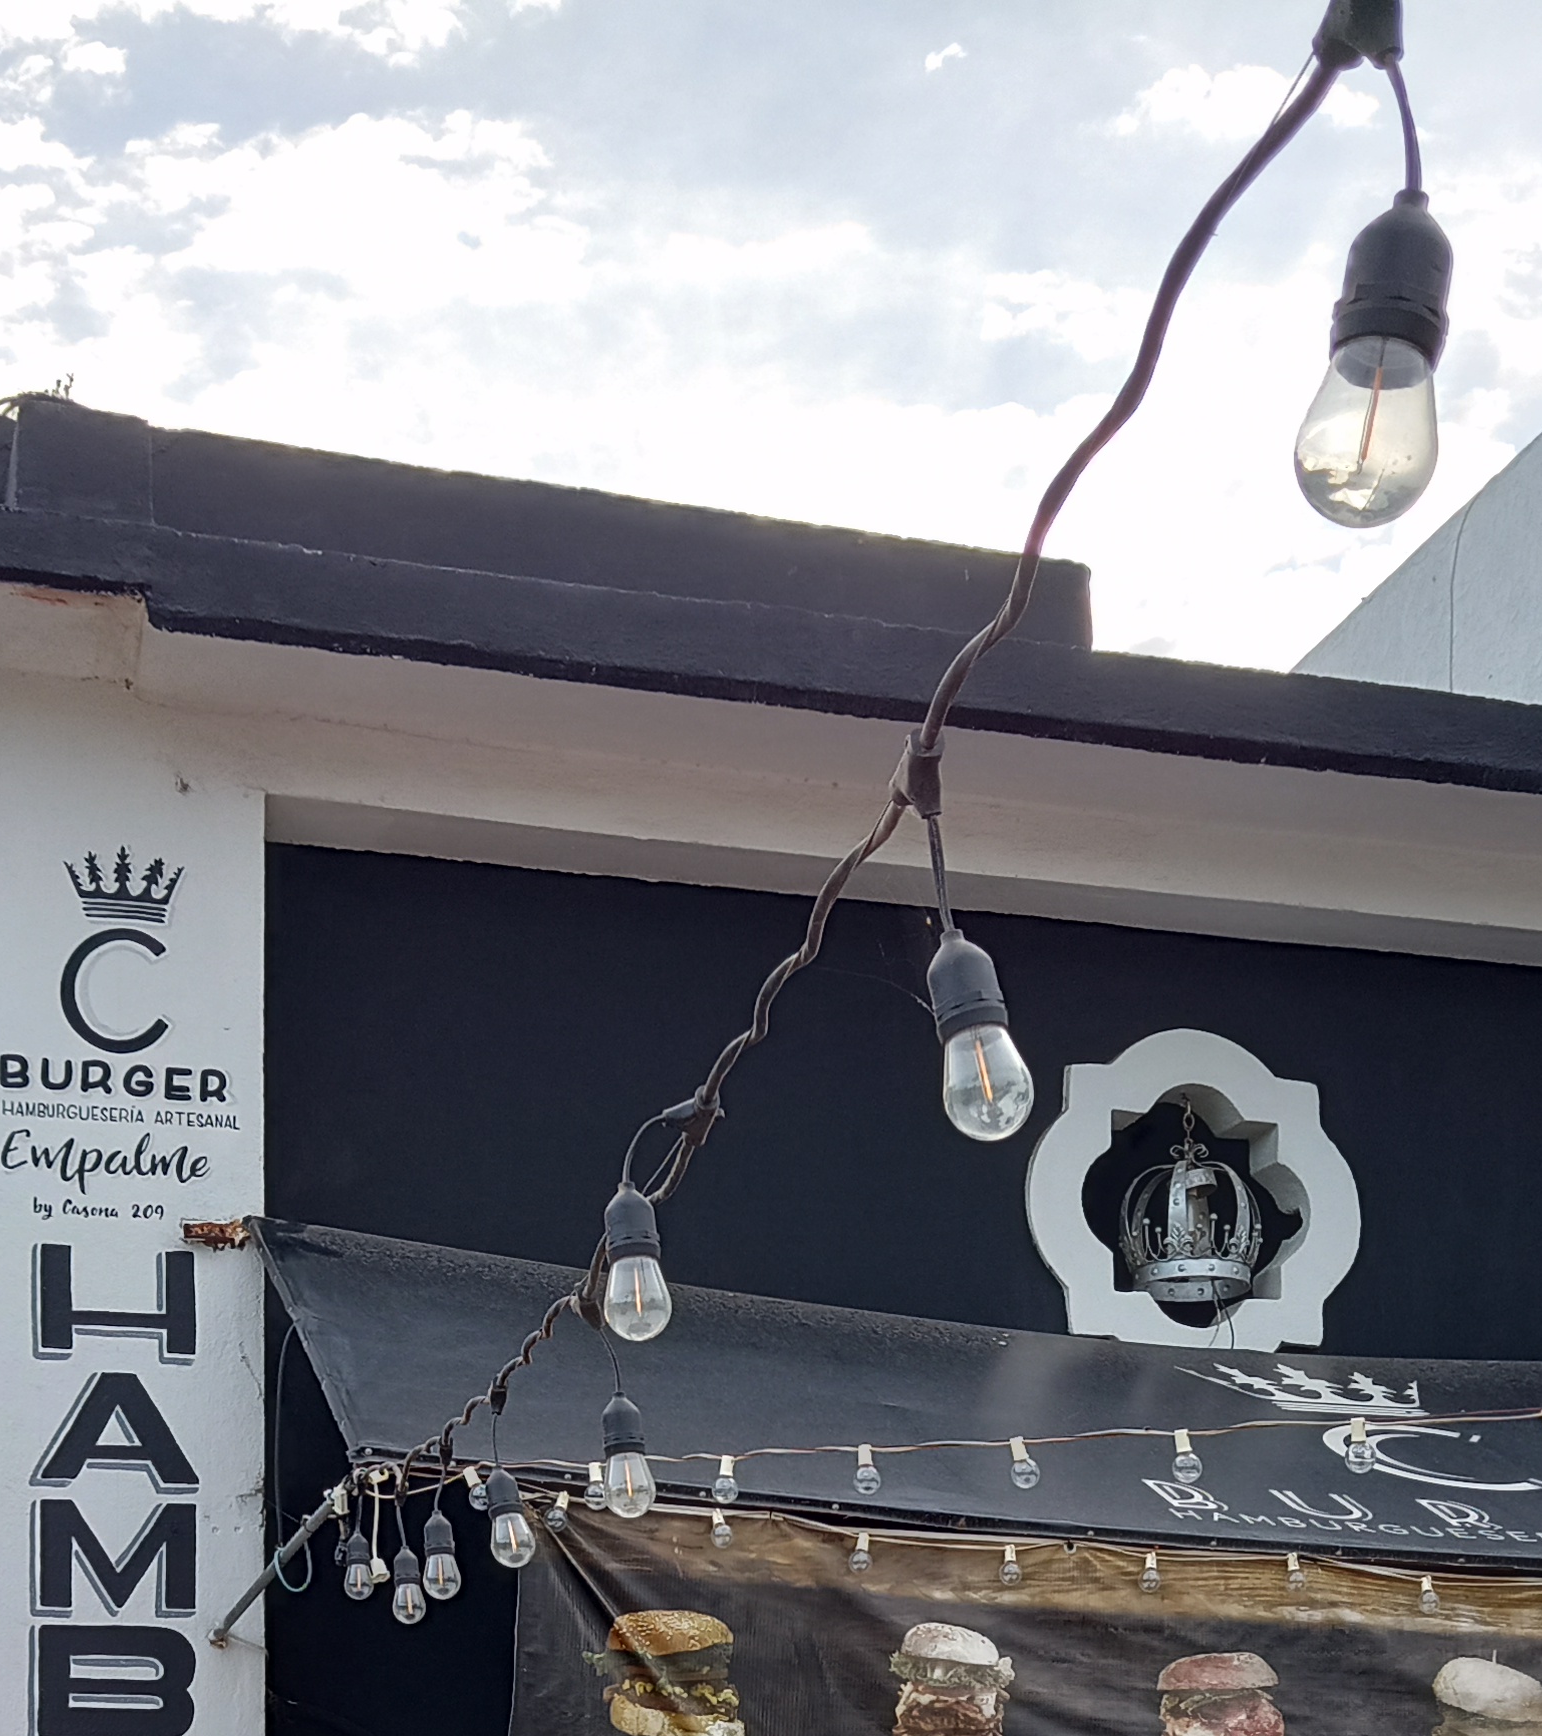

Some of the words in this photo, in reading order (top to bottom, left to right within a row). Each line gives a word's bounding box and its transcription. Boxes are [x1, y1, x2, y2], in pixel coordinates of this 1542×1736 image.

[59, 927, 170, 1055] C
[153, 1110, 241, 1131] ARTESANAL
[0, 1128, 211, 1195] Empalme
[32, 1196, 53, 1220] by
[61, 1198, 119, 1219] Casona
[131, 1203, 165, 1220] 209
